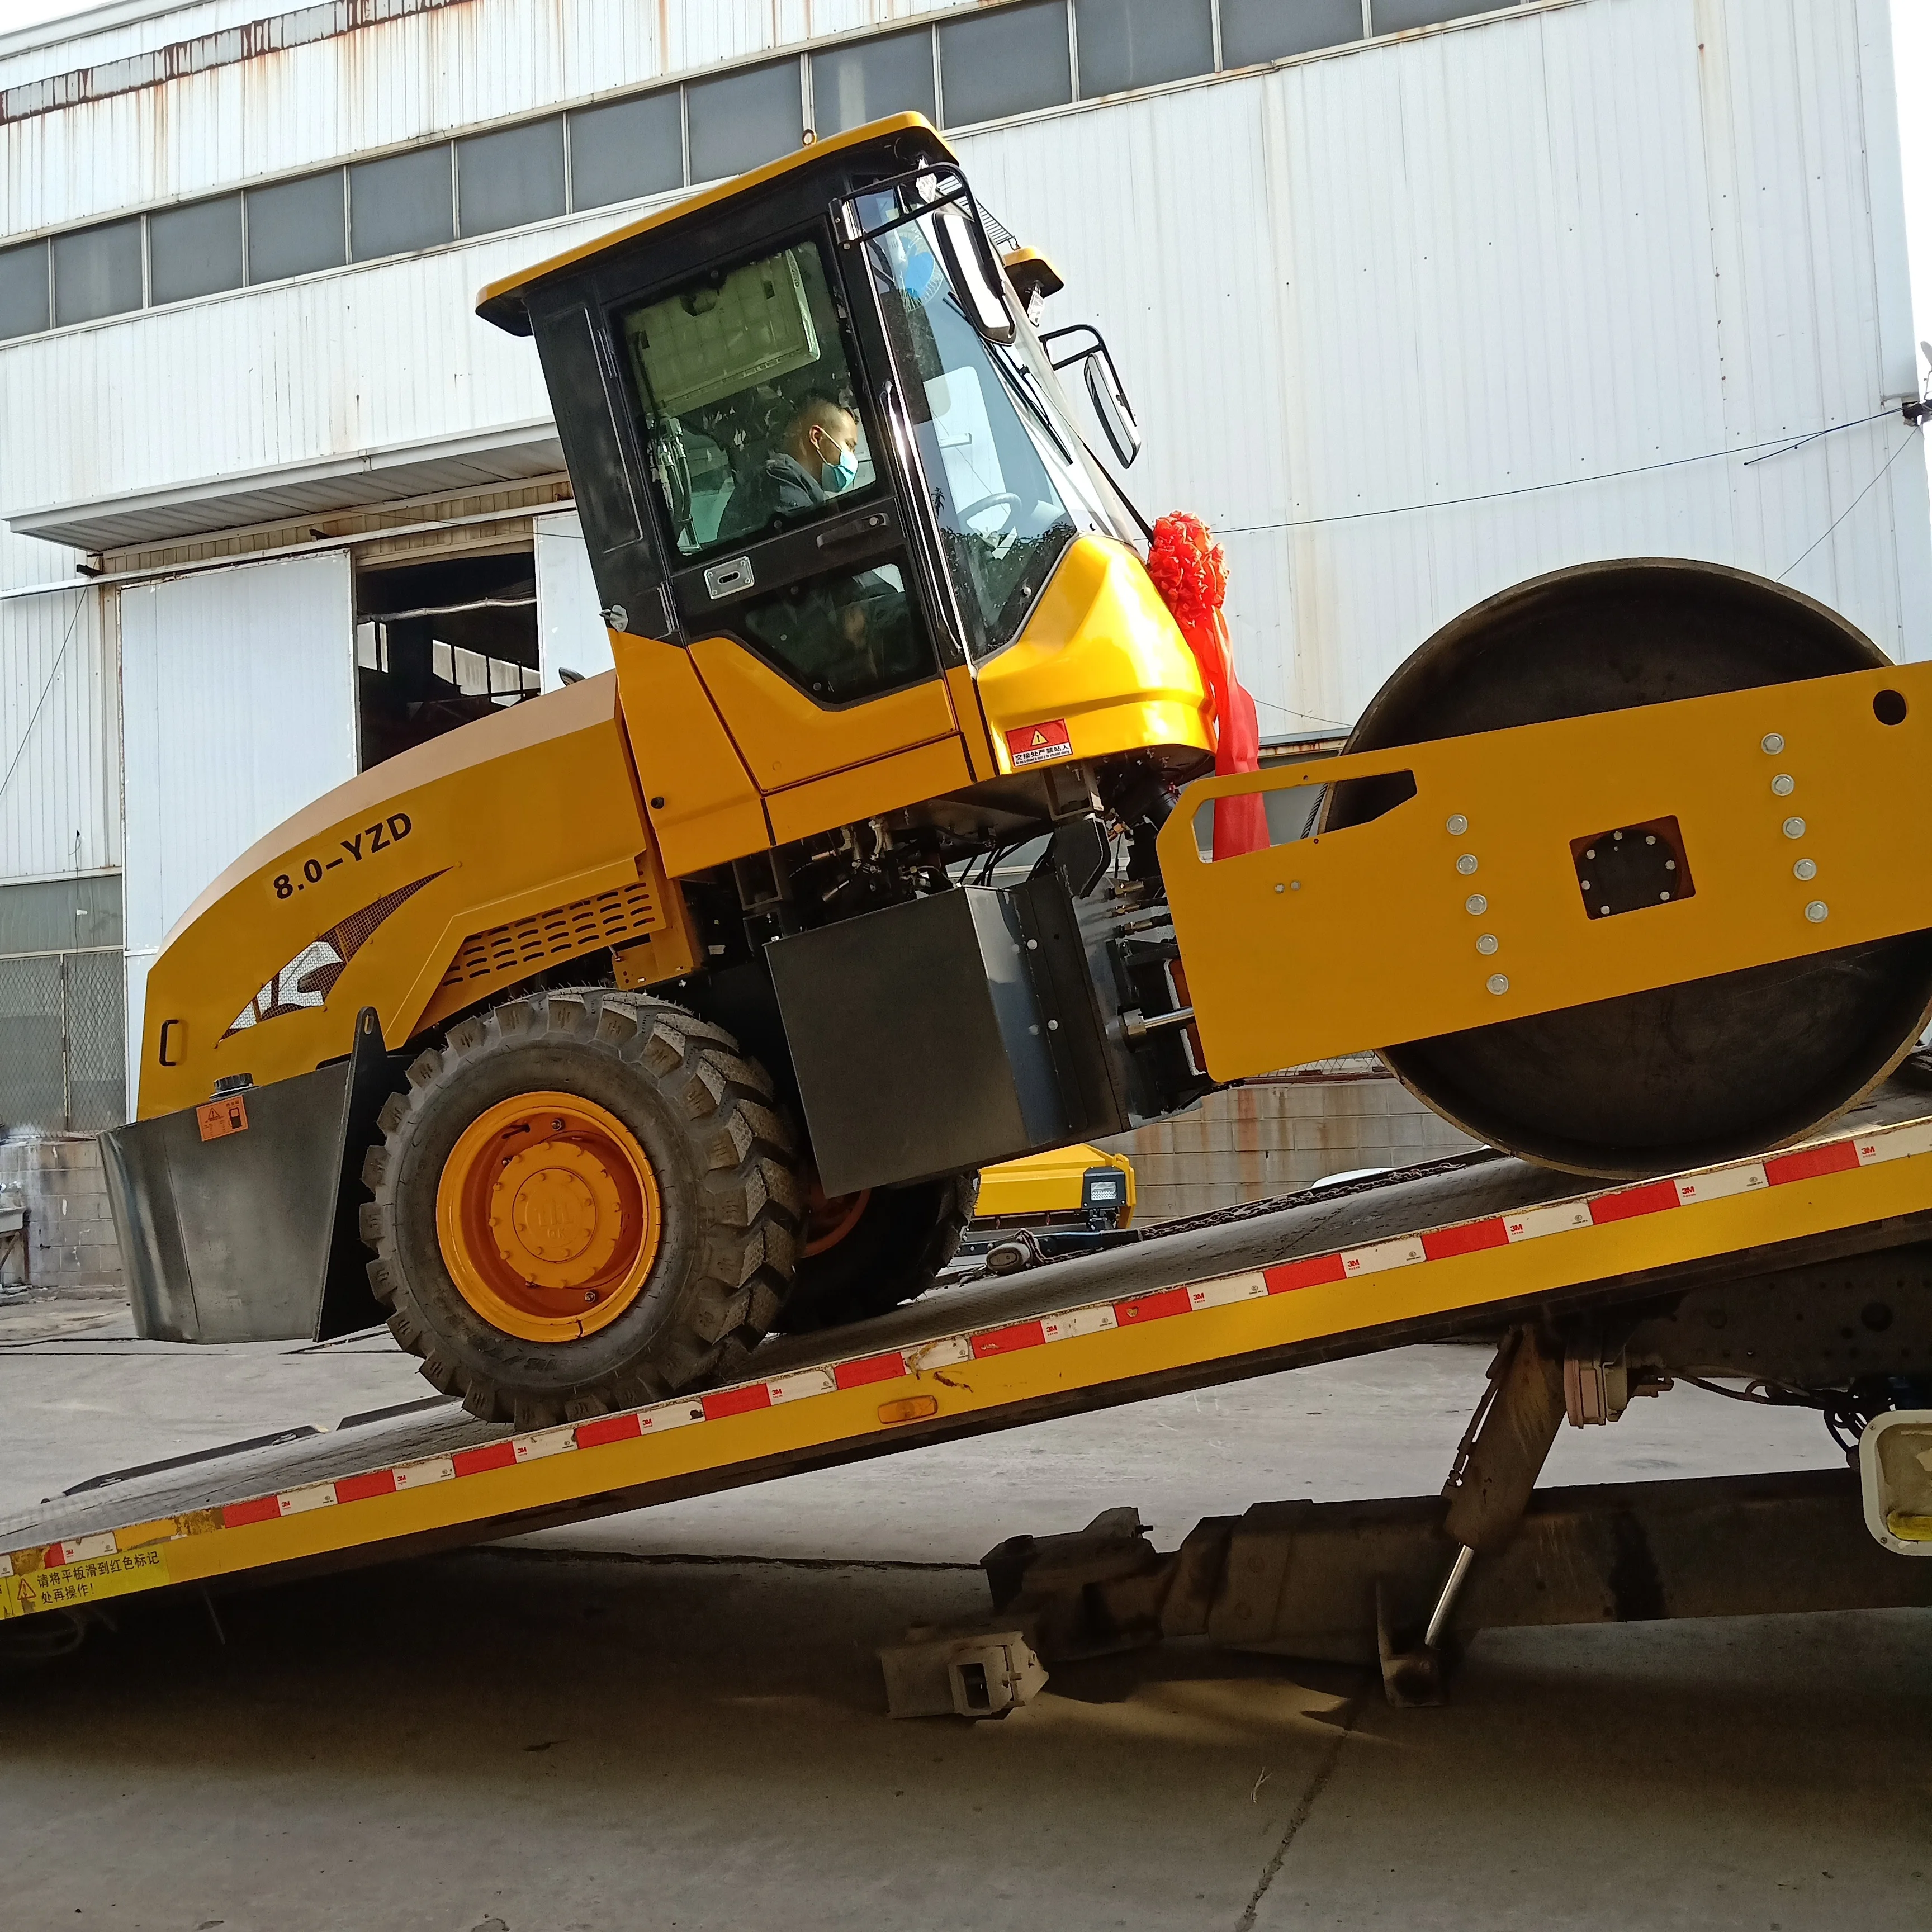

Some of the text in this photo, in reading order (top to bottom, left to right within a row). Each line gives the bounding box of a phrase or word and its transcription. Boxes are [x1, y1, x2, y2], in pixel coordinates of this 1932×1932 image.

[1015, 744, 1069, 761] 交接处严禁站人
[273, 812, 412, 899] 8.0-YZD
[1861, 1145, 1875, 1154] 3M
[1682, 1186, 1696, 1195] 3M
[1510, 1224, 1523, 1232] 3M
[1347, 1259, 1360, 1267] 3M
[1193, 1292, 1205, 1301] 3M
[37, 1550, 160, 1589] 请将平板滑到红色标记
[41, 1583, 94, 1605] 处再操作!
